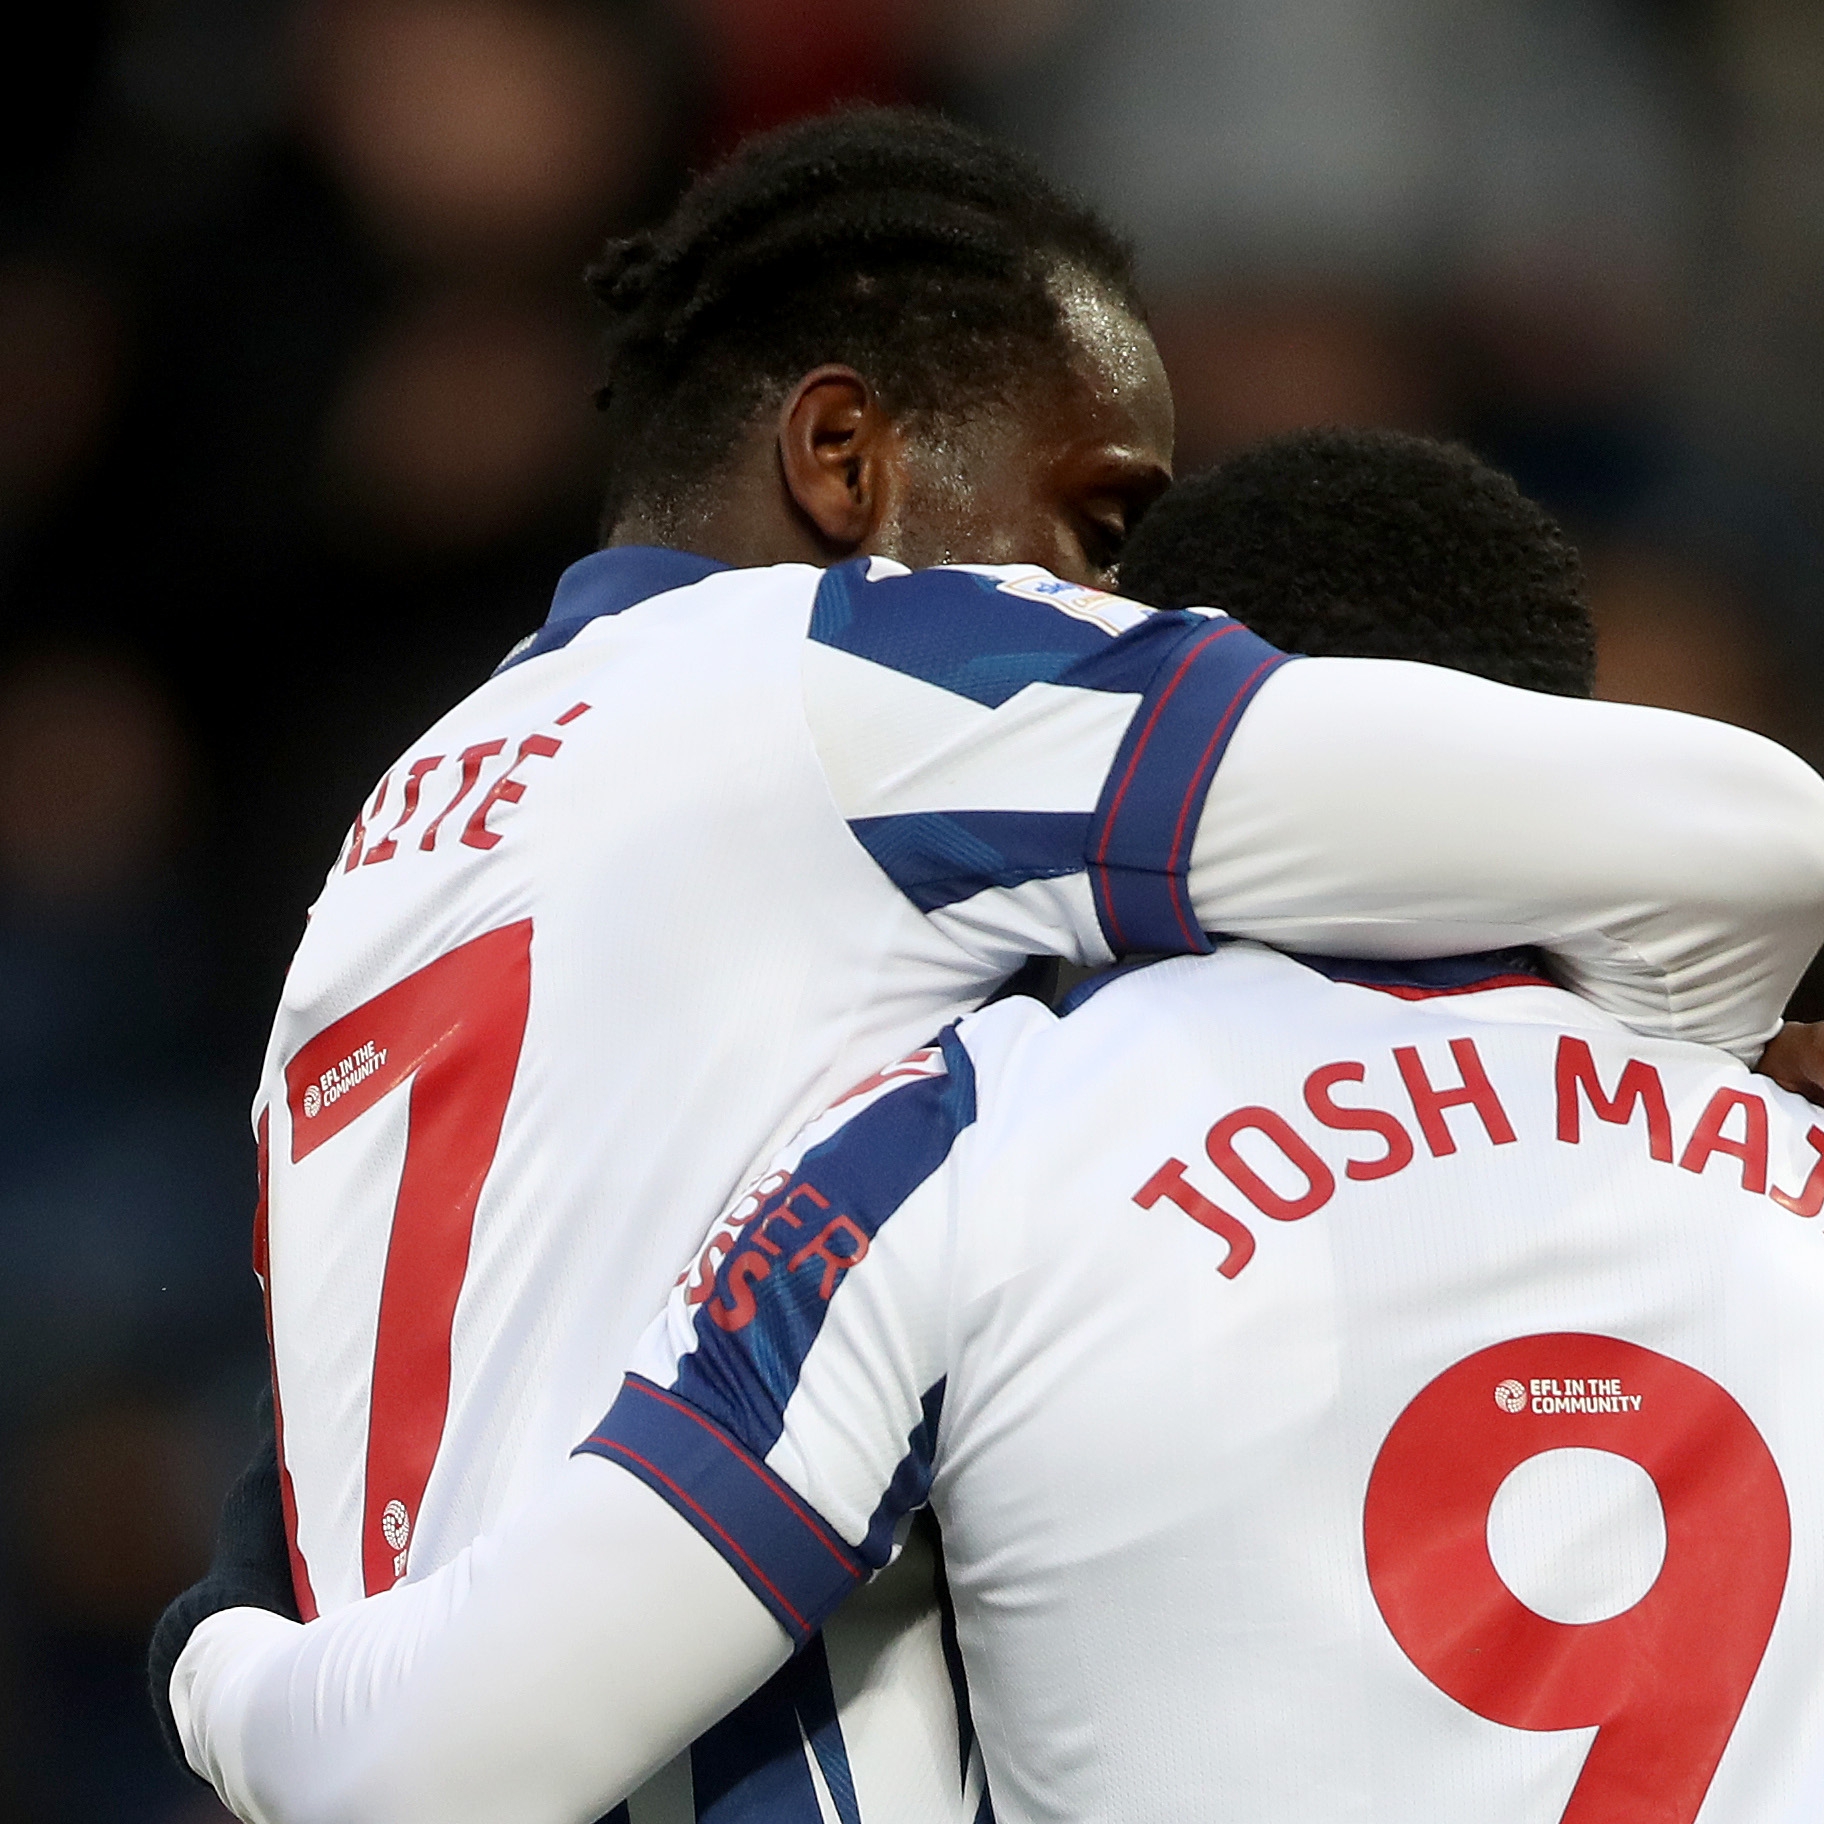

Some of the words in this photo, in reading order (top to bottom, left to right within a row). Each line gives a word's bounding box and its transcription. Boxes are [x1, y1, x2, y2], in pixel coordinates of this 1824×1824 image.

[319, 1067, 341, 1091] EFL
[338, 1056, 354, 1078] IN
[352, 1040, 375, 1066] THE
[323, 1048, 387, 1107] COMMUNITY
[1130, 1036, 1517, 1280] JOSH
[1529, 1378, 1562, 1396] EFL
[1563, 1378, 1585, 1396] IN
[1587, 1378, 1622, 1396] THE
[1530, 1395, 1643, 1415] COMMUNITY
